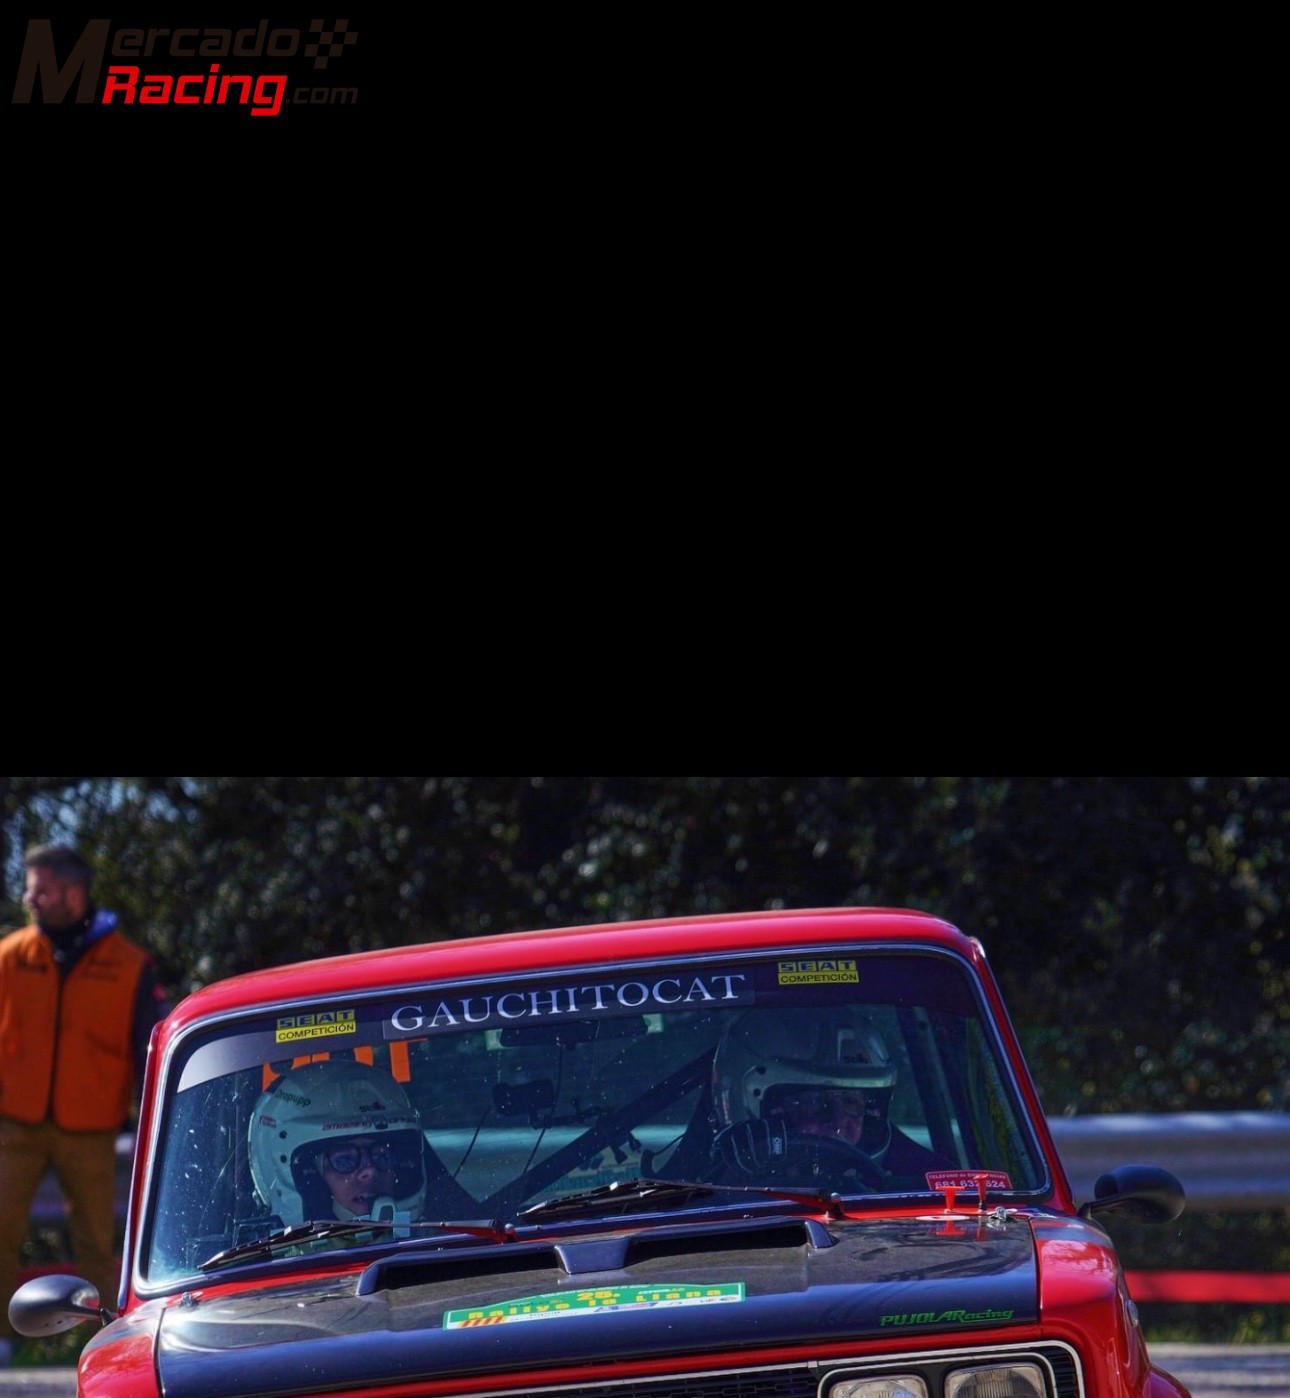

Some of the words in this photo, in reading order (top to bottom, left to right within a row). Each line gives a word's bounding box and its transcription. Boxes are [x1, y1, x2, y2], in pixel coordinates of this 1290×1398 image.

[779, 961, 855, 972] SEAT
[780, 972, 858, 983] COMPETICIÓN
[391, 974, 746, 1032] GAUCHITOCAT
[278, 1009, 354, 1031] SEAT
[278, 1023, 354, 1041] COMPETICIÓN
